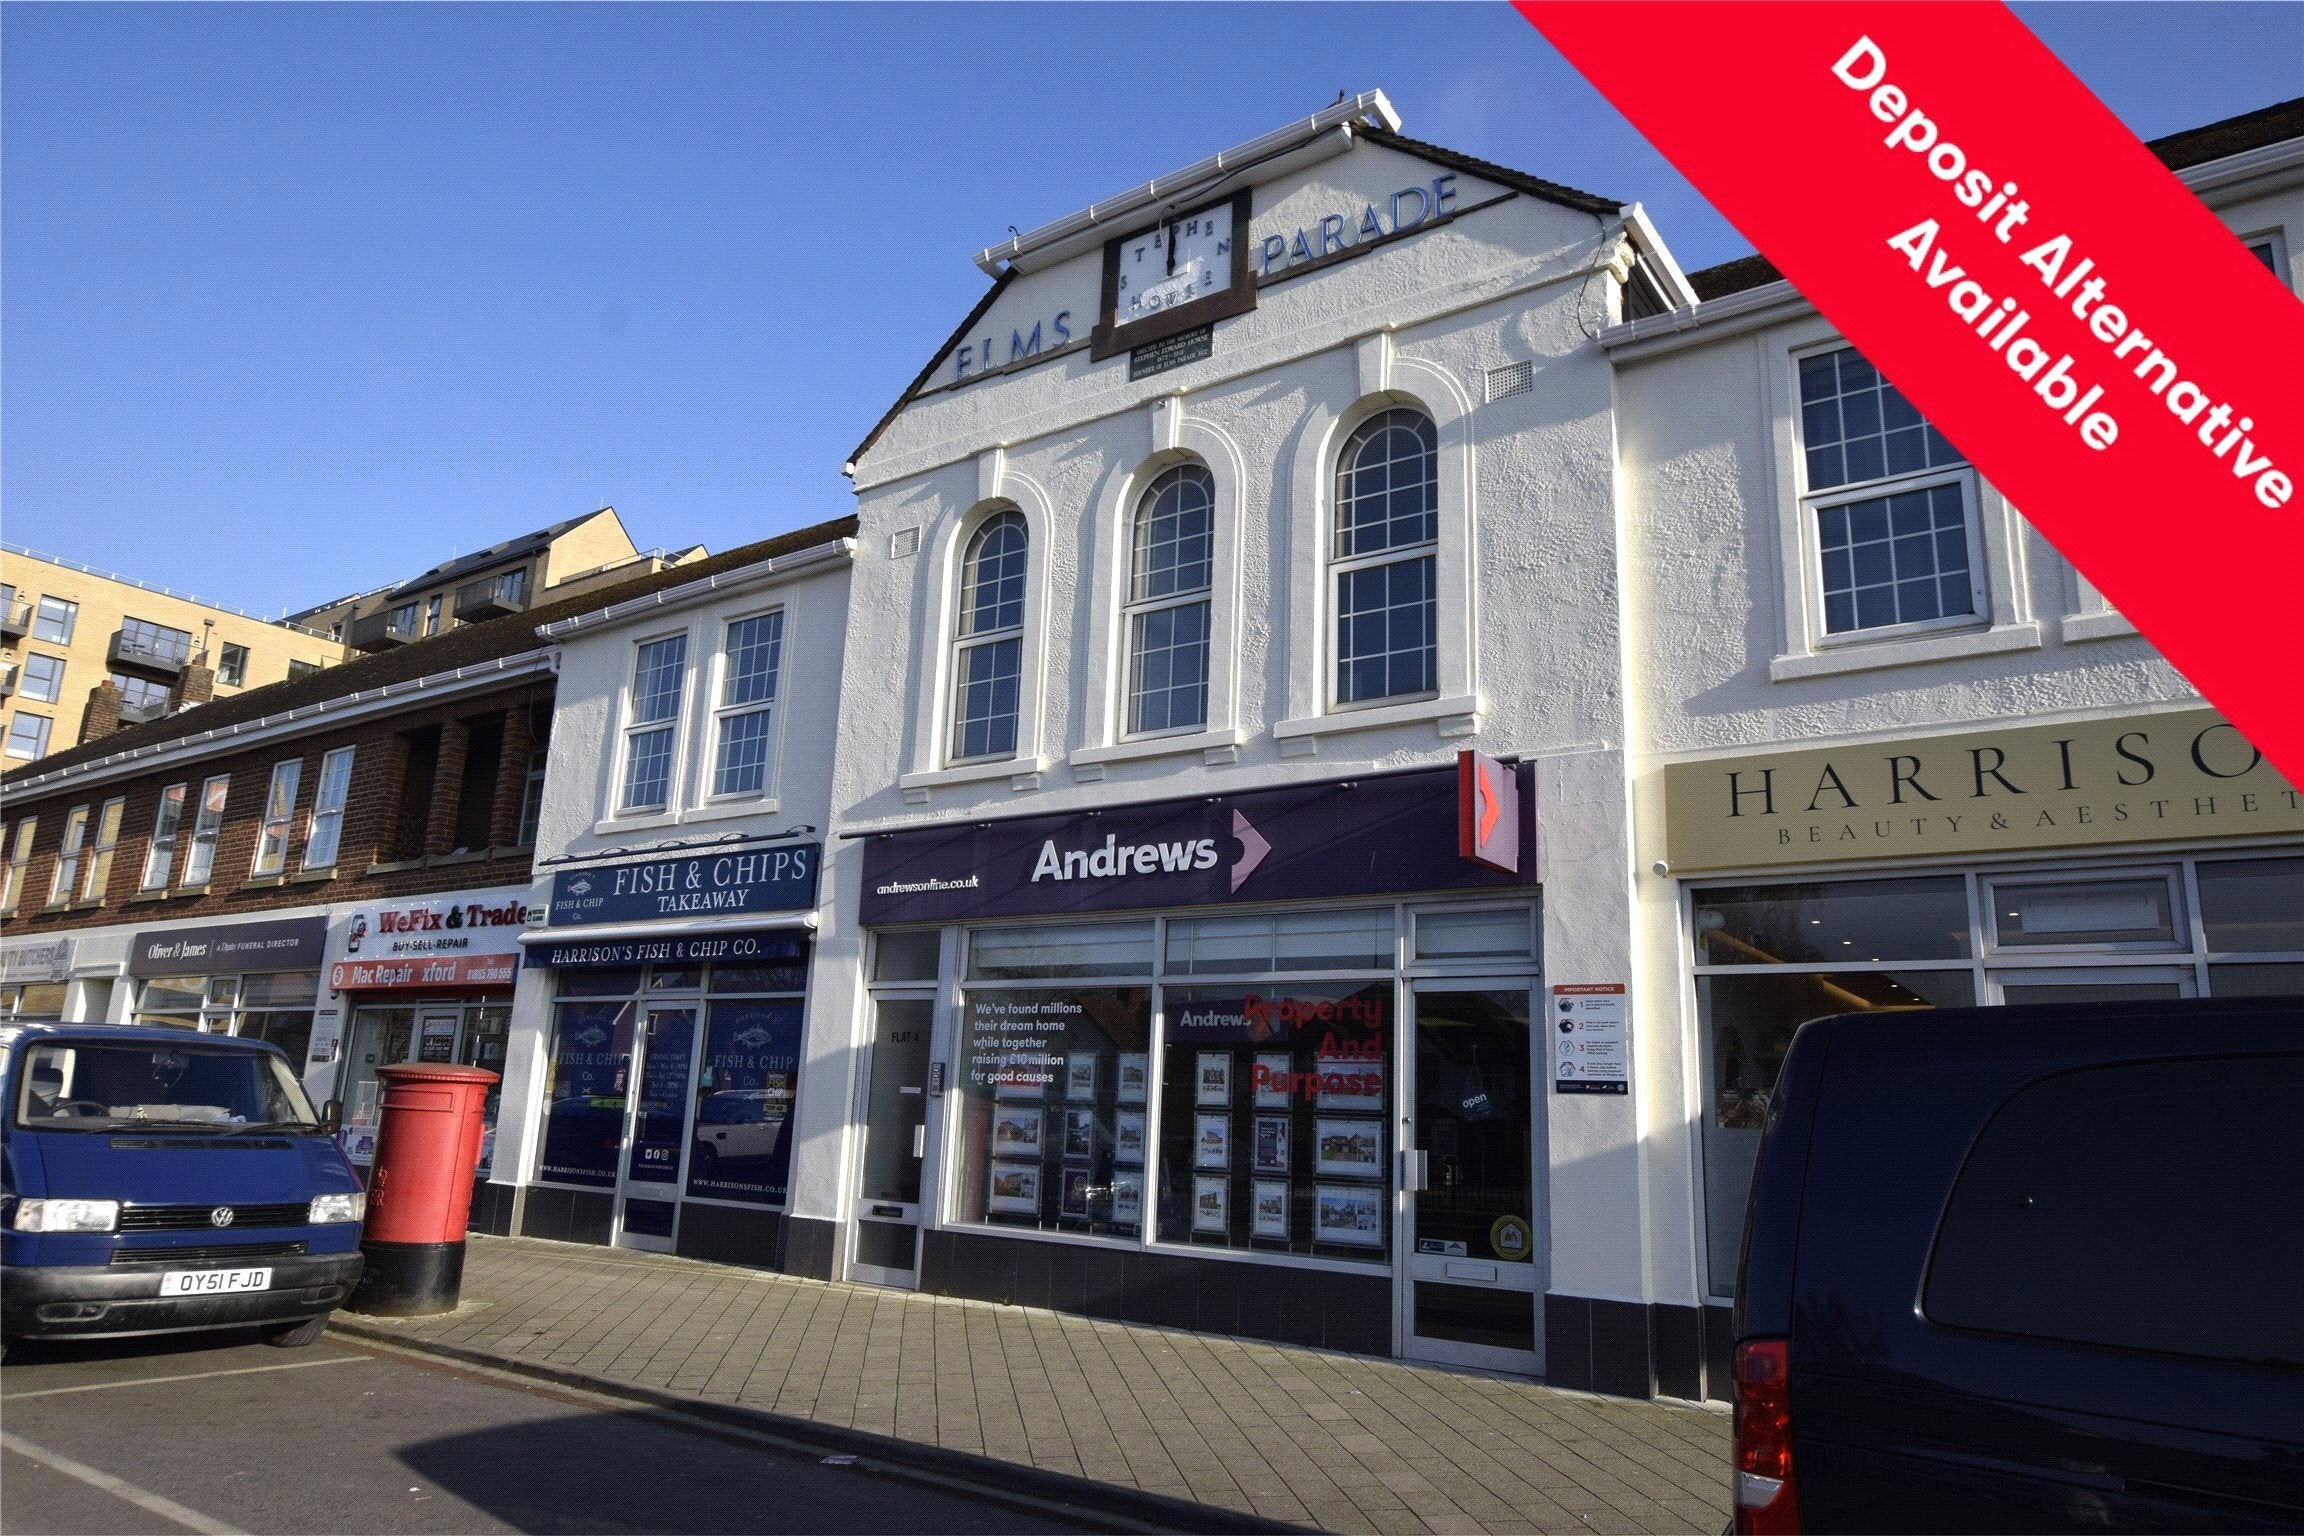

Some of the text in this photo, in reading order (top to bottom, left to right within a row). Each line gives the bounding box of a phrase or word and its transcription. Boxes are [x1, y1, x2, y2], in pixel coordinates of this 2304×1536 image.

[956, 173, 1458, 381] ELMS PARADE
[1777, 815, 1963, 846] BEAUTY
[1990, 811, 2010, 831] &
[1030, 833, 1219, 882] Andrews
[613, 849, 807, 896] FISH & CHIPS
[877, 875, 979, 894] andrewsonline.co.uk
[556, 897, 604, 910] FISH & CHIP
[657, 889, 750, 913] TAKEAWAY
[379, 908, 444, 934] WeFix
[446, 906, 463, 929] &
[148, 941, 207, 960] Oliver & James
[237, 941, 265, 950] FUNERAL
[267, 938, 299, 949] DIRECTOR
[392, 937, 469, 952] BUY-SELL-REPAIR
[552, 938, 761, 964] HARRISON'S FISH & CHIP CO.
[352, 966, 373, 984] Mac
[375, 963, 414, 988] Repair
[975, 1002, 1082, 1015] We've found millions
[1243, 993, 1382, 1029] Property
[974, 1020, 1065, 1031] their dream home
[891, 1032, 911, 1043] FLAT
[973, 1037, 1047, 1050] while together
[1319, 1030, 1382, 1059] And
[559, 1052, 584, 1065] FISH
[586, 1053, 593, 1065] &
[714, 1054, 793, 1069] FISH & CHIP
[972, 1054, 1007, 1067] raising
[1028, 1054, 1064, 1065] million
[582, 1071, 595, 1080] Co.
[743, 1075, 758, 1086] Co.
[970, 1070, 1054, 1084] for good causes
[1251, 1063, 1383, 1103] Purpose
[1462, 1092, 1487, 1109] open
[180, 1271, 264, 1291] OY51 FJD
